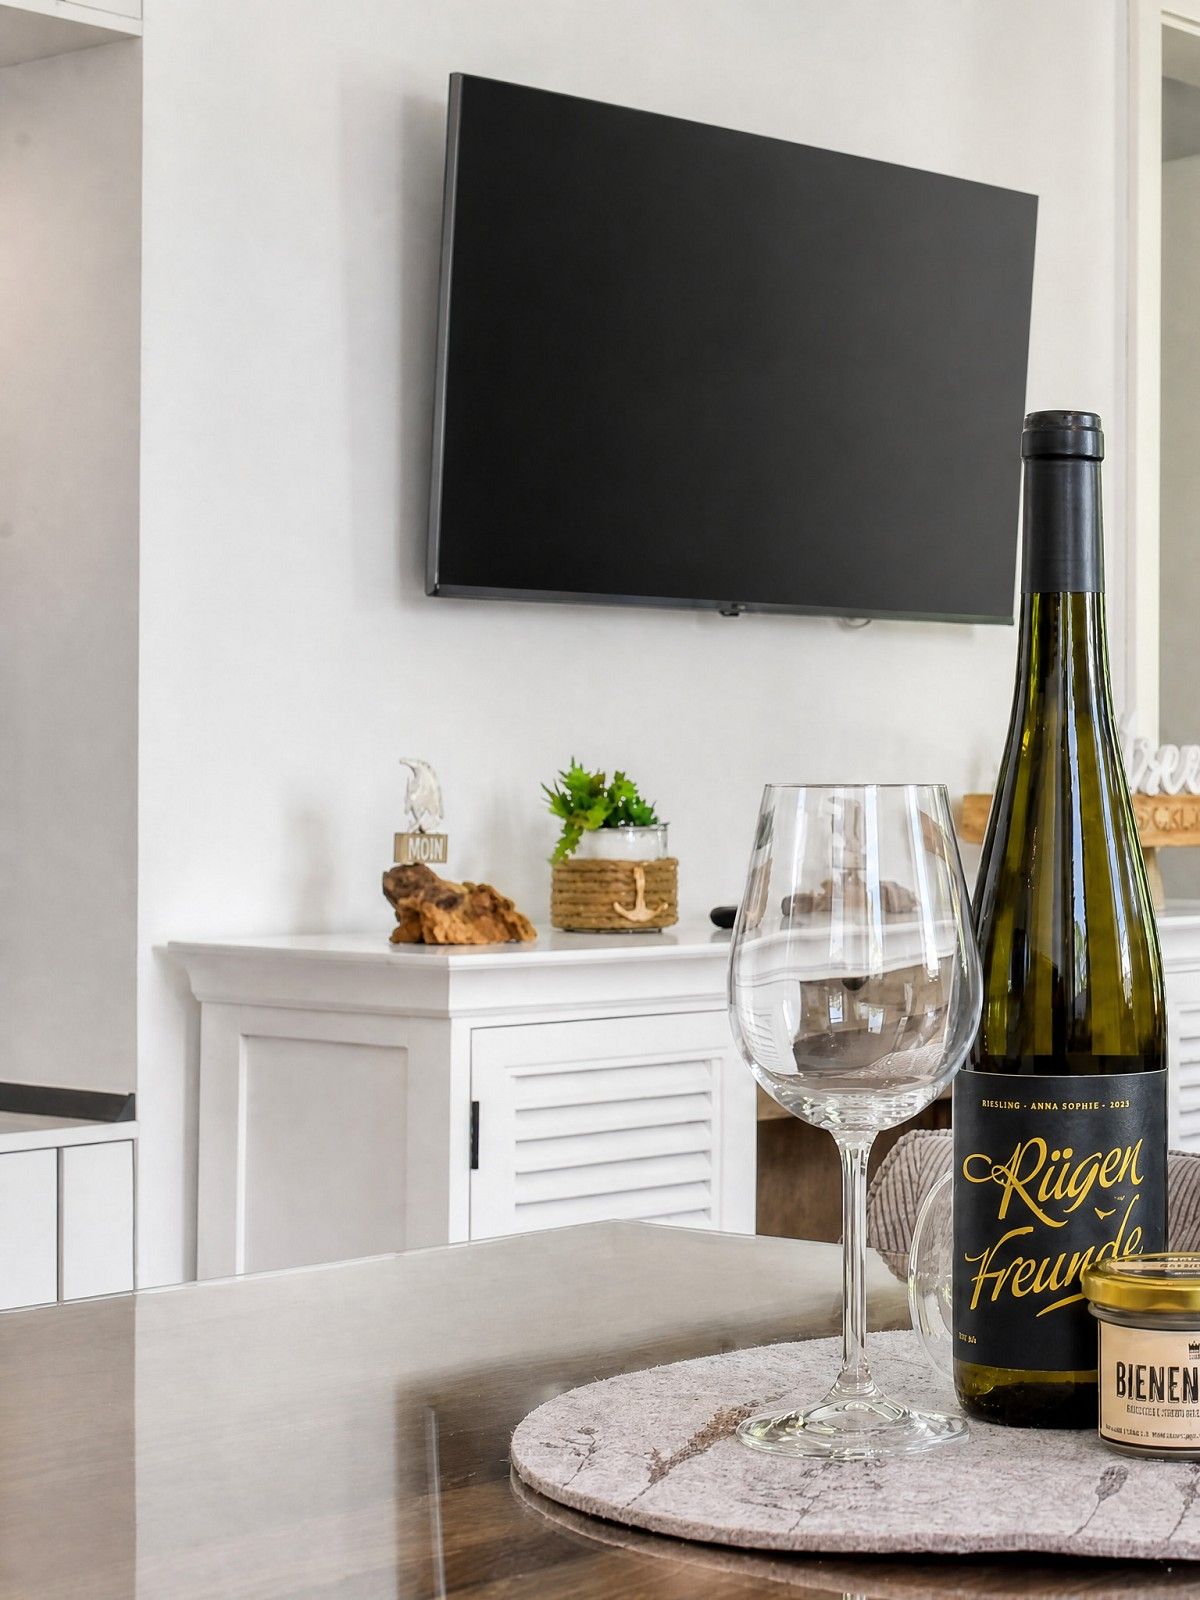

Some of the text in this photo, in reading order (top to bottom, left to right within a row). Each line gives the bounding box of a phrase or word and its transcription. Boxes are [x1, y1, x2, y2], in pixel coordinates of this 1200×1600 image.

[408, 836, 444, 861] MOIN
[982, 1099, 1021, 1110] RIESLING
[1030, 1101, 1059, 1110] ANNA
[1062, 1100, 1100, 1110] SOPHIE
[962, 1137, 1144, 1228] Rügen
[965, 1194, 1144, 1311] Freunde
